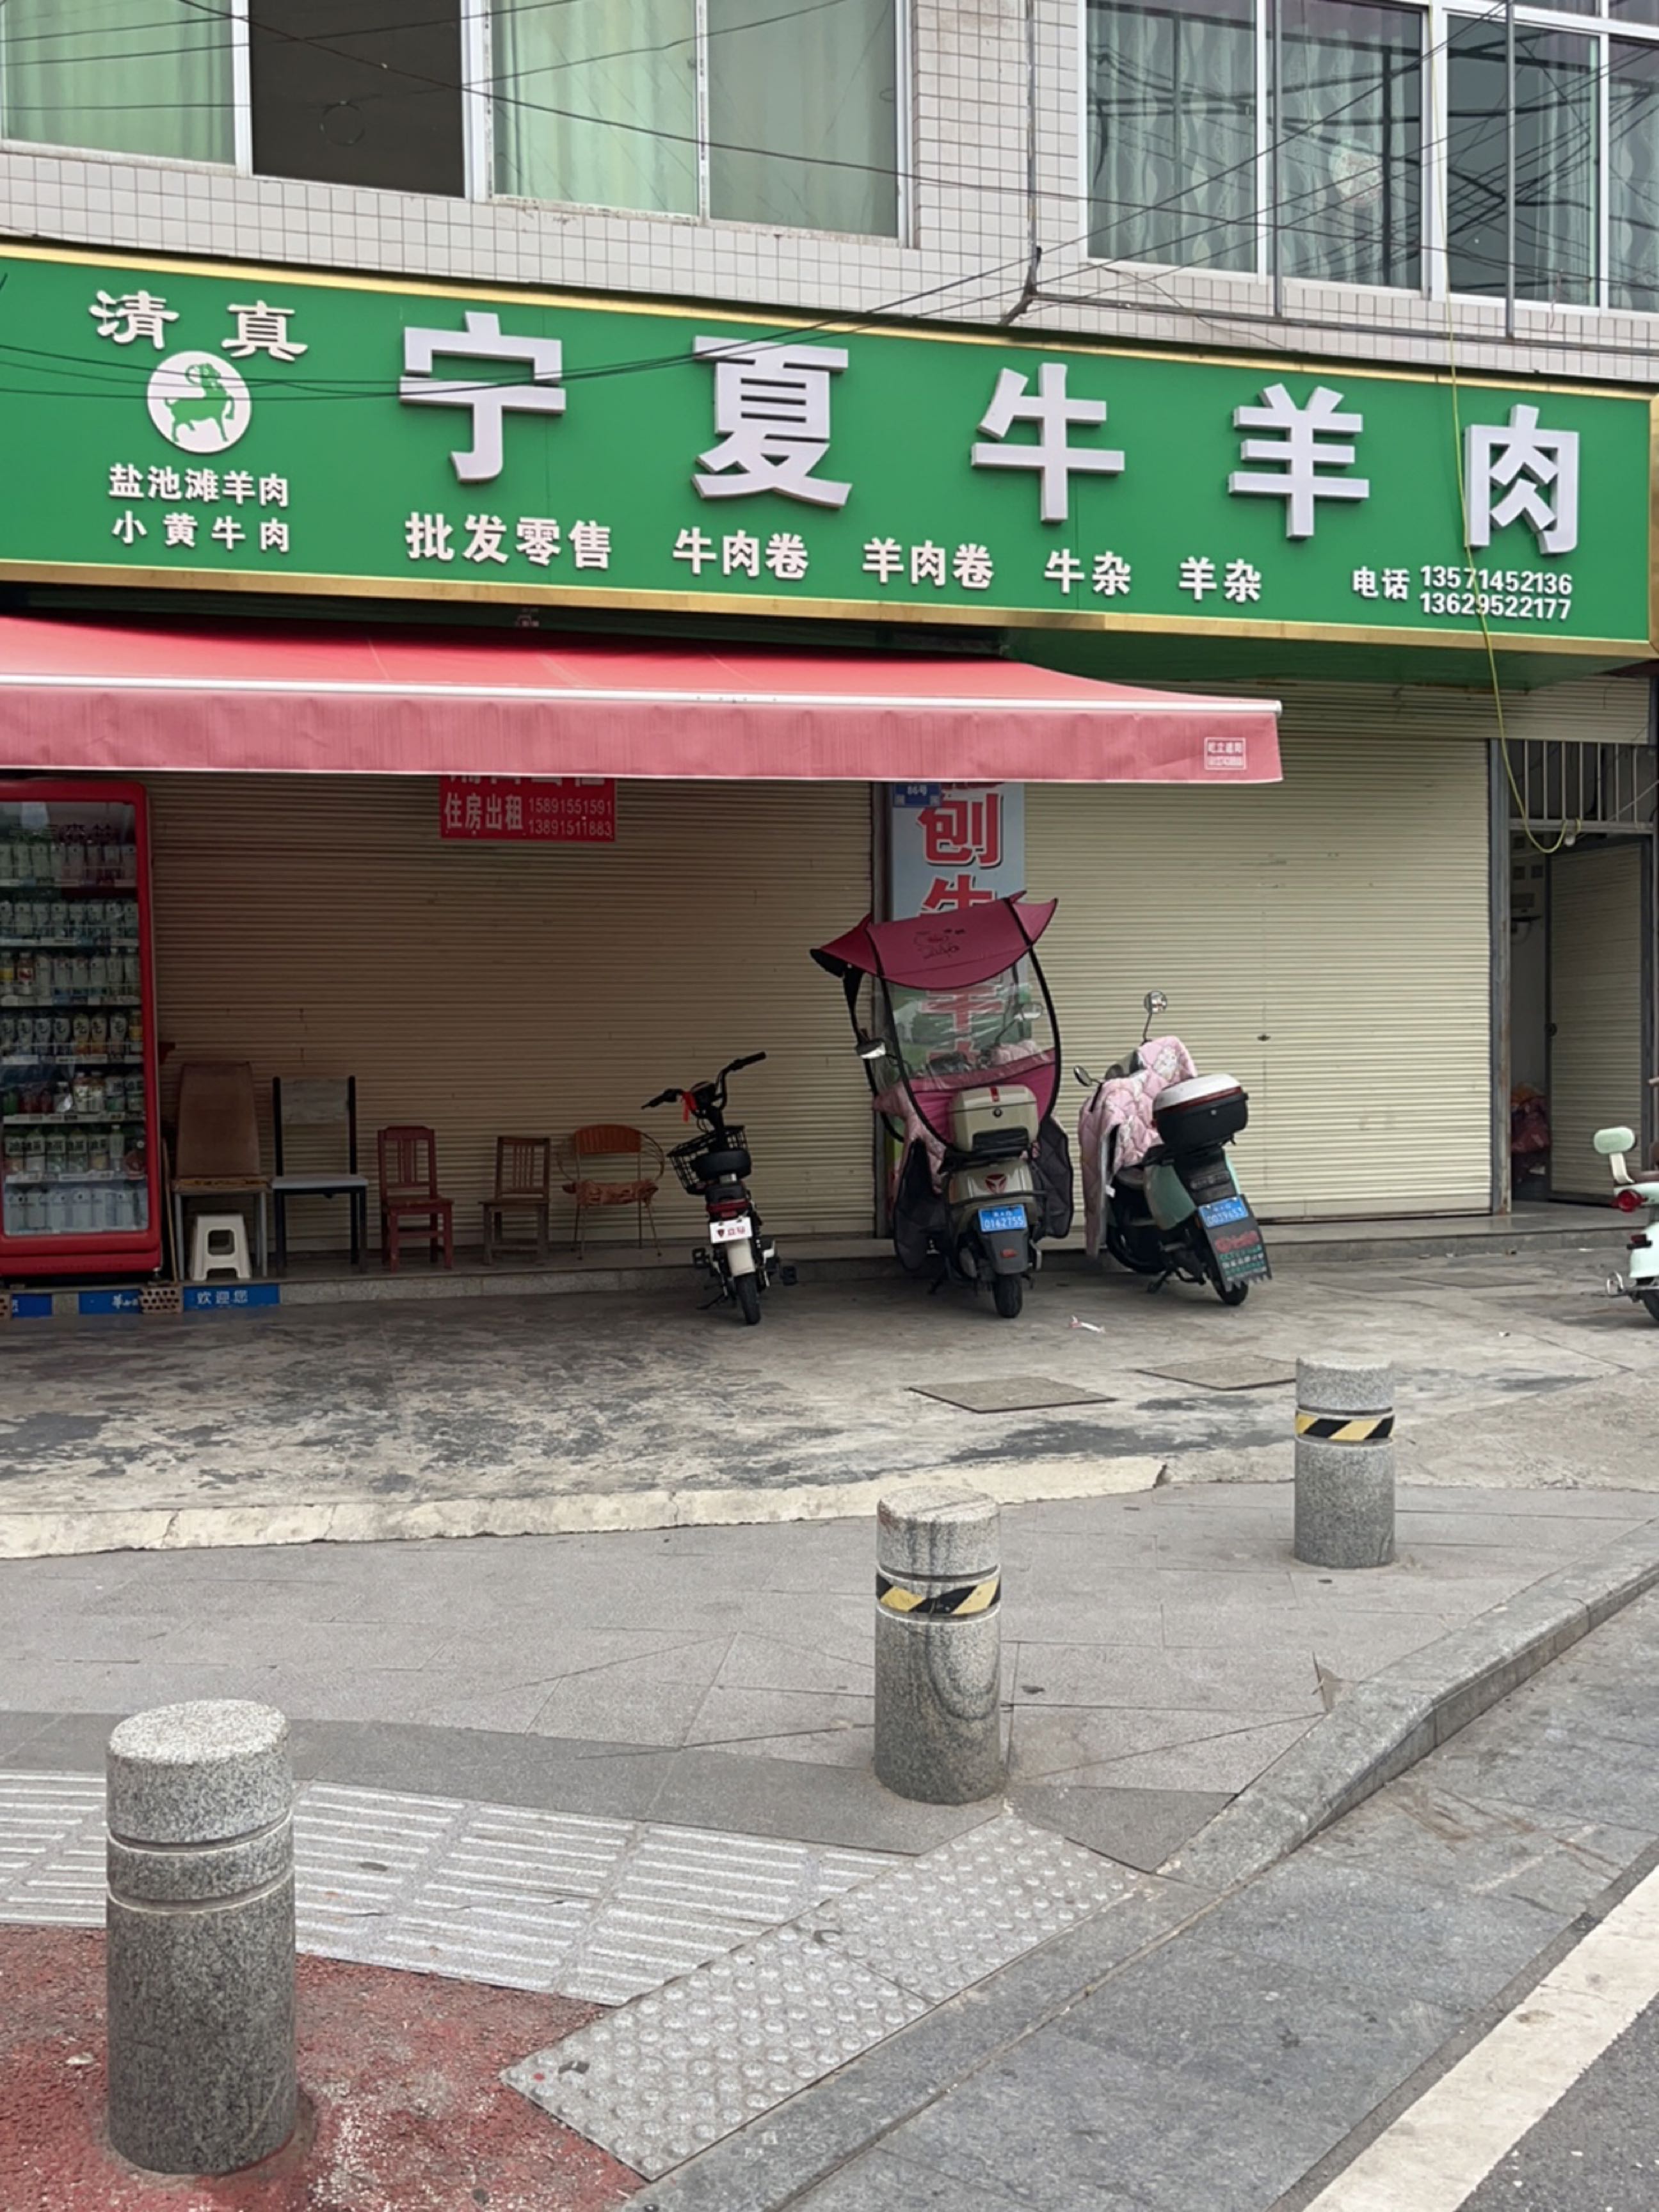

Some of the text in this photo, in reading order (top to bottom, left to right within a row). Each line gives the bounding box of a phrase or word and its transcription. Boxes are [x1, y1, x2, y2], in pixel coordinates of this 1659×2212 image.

[88, 290, 308, 362] 清真
[399, 310, 1580, 556] 宁夏牛羊肉
[109, 463, 289, 508] 盐池滩羊肉
[111, 510, 290, 552] 小黄牛肉
[405, 512, 1262, 602] 批发零售 牛肉卷 羊肉卷 牛杂 羊杂
[1352, 565, 1572, 600] 电话 13571452136
[1420, 592, 1571, 620] 13629522177
[444, 792, 523, 830] 住房出租
